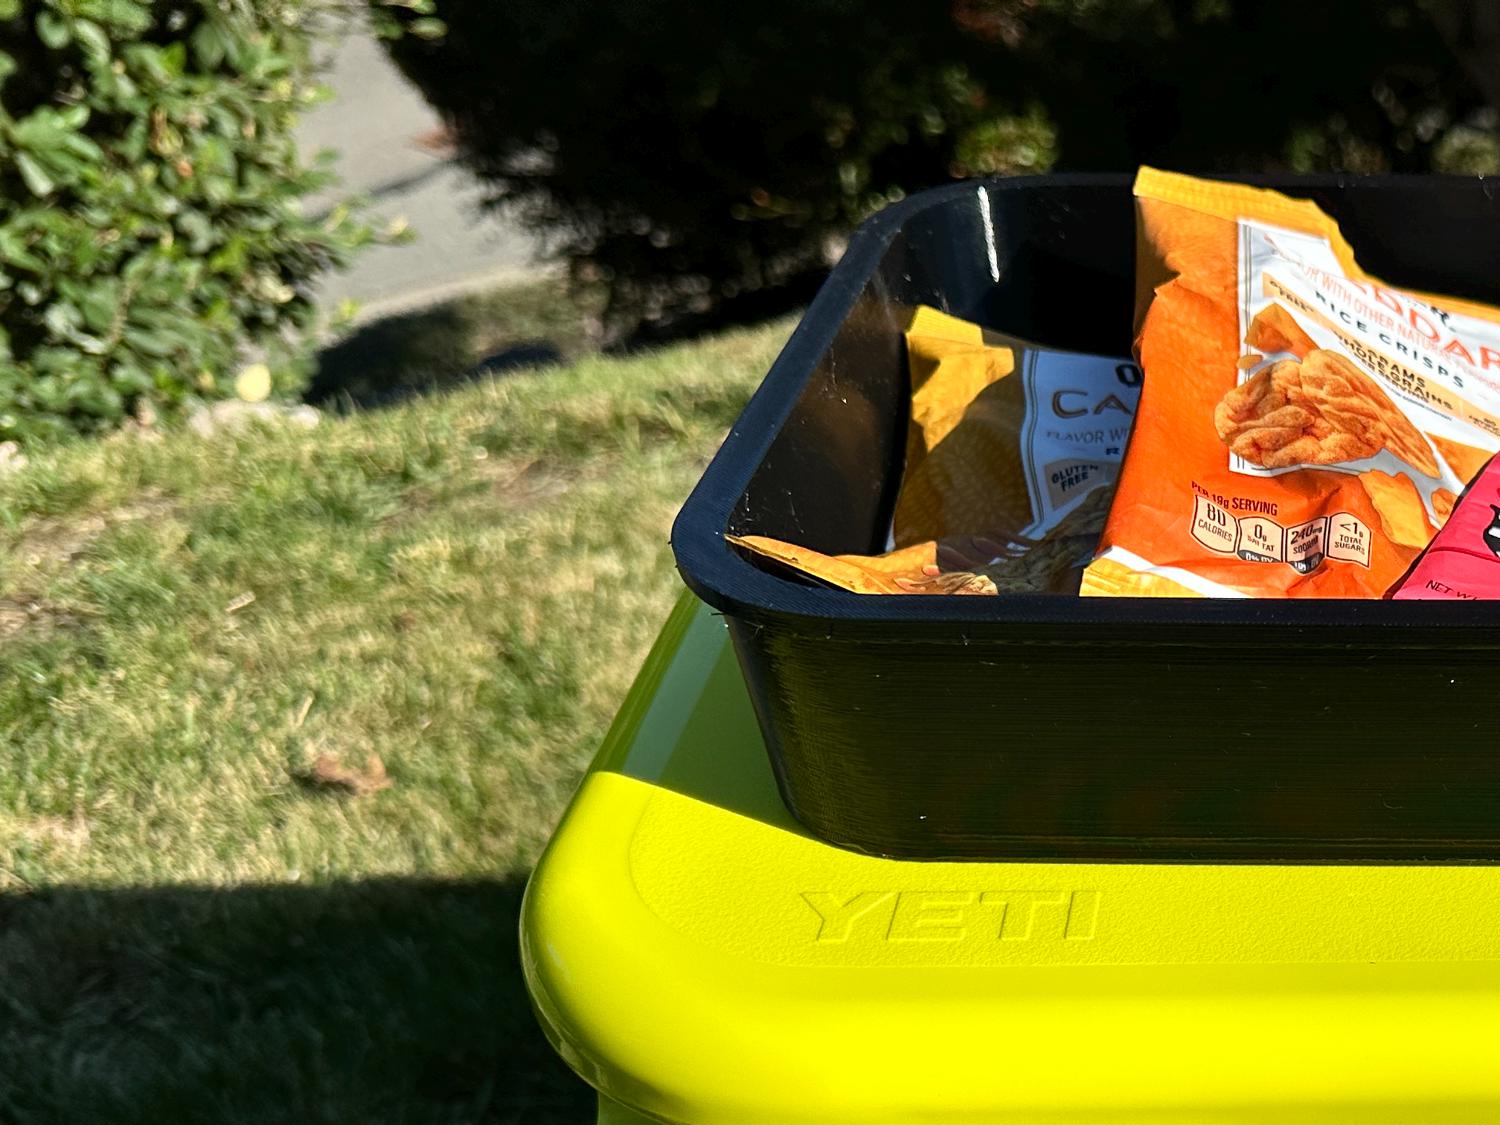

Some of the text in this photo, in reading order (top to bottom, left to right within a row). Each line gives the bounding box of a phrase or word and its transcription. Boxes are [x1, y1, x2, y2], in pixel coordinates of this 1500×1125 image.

[1354, 298, 1394, 331] OTHER
[1379, 332, 1464, 389] CRISPS
[1389, 371, 1453, 411] GRAINS
[1047, 429, 1105, 445] FLAVOR
[1052, 463, 1098, 484] GLUTEN
[1060, 470, 1089, 492] FREE
[1206, 502, 1227, 527] 80
[1232, 496, 1279, 517] SERVING
[1198, 518, 1233, 543] CALORIES
[1339, 534, 1363, 546] TOTAL
[1334, 541, 1366, 556] SUGARS
[1425, 579, 1454, 594] NET
[798, 889, 1102, 943] YETI
